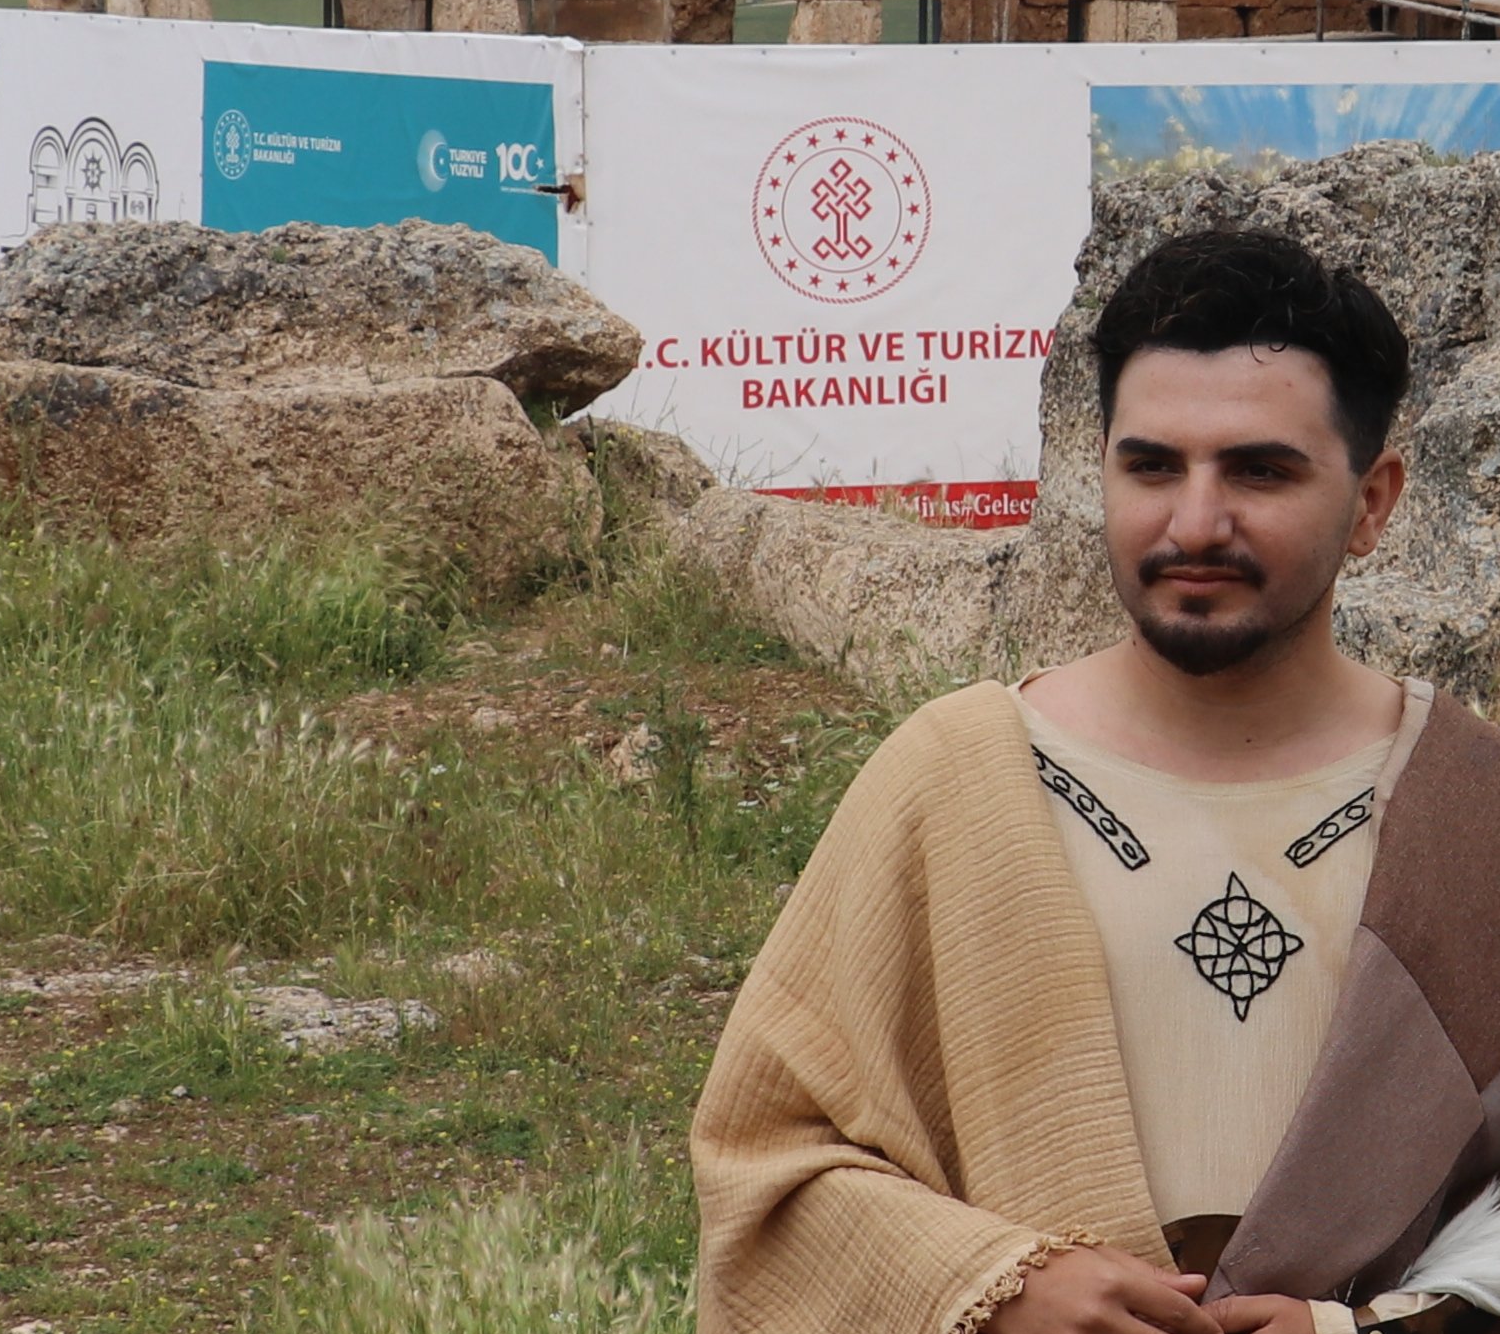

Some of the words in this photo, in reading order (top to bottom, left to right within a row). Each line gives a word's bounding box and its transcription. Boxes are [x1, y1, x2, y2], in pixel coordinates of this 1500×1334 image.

[637, 337, 690, 369] .C.
[701, 328, 847, 367] KÜLTÜR
[859, 331, 905, 362] VE
[916, 322, 1057, 361] TURİZM
[742, 368, 948, 409] BAKANLIĞI
